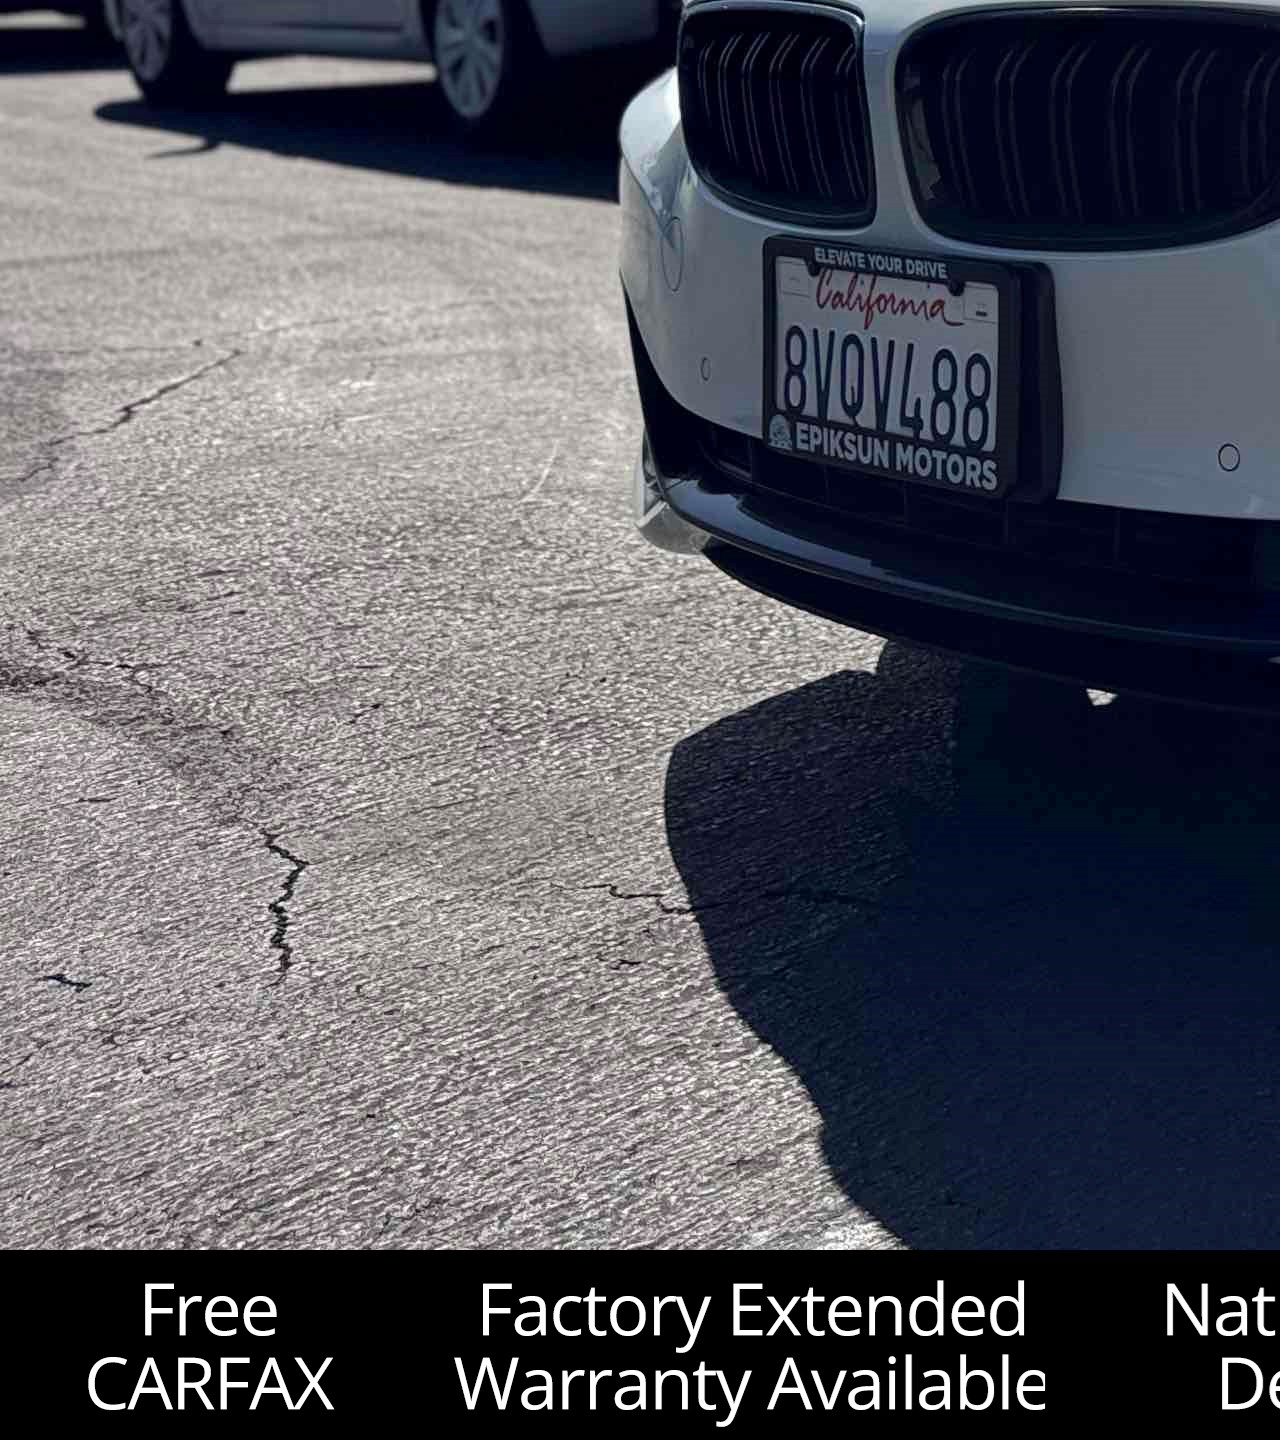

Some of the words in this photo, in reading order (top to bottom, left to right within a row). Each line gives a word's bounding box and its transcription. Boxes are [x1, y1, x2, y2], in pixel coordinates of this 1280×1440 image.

[814, 247, 866, 269] ELEVATE
[867, 254, 903, 274] YOUR
[905, 259, 948, 280] DRIVE
[815, 268, 966, 330] California
[783, 325, 992, 450] 8VQV488
[795, 422, 890, 470] EPIKSUN
[895, 445, 998, 492] MOTORS
